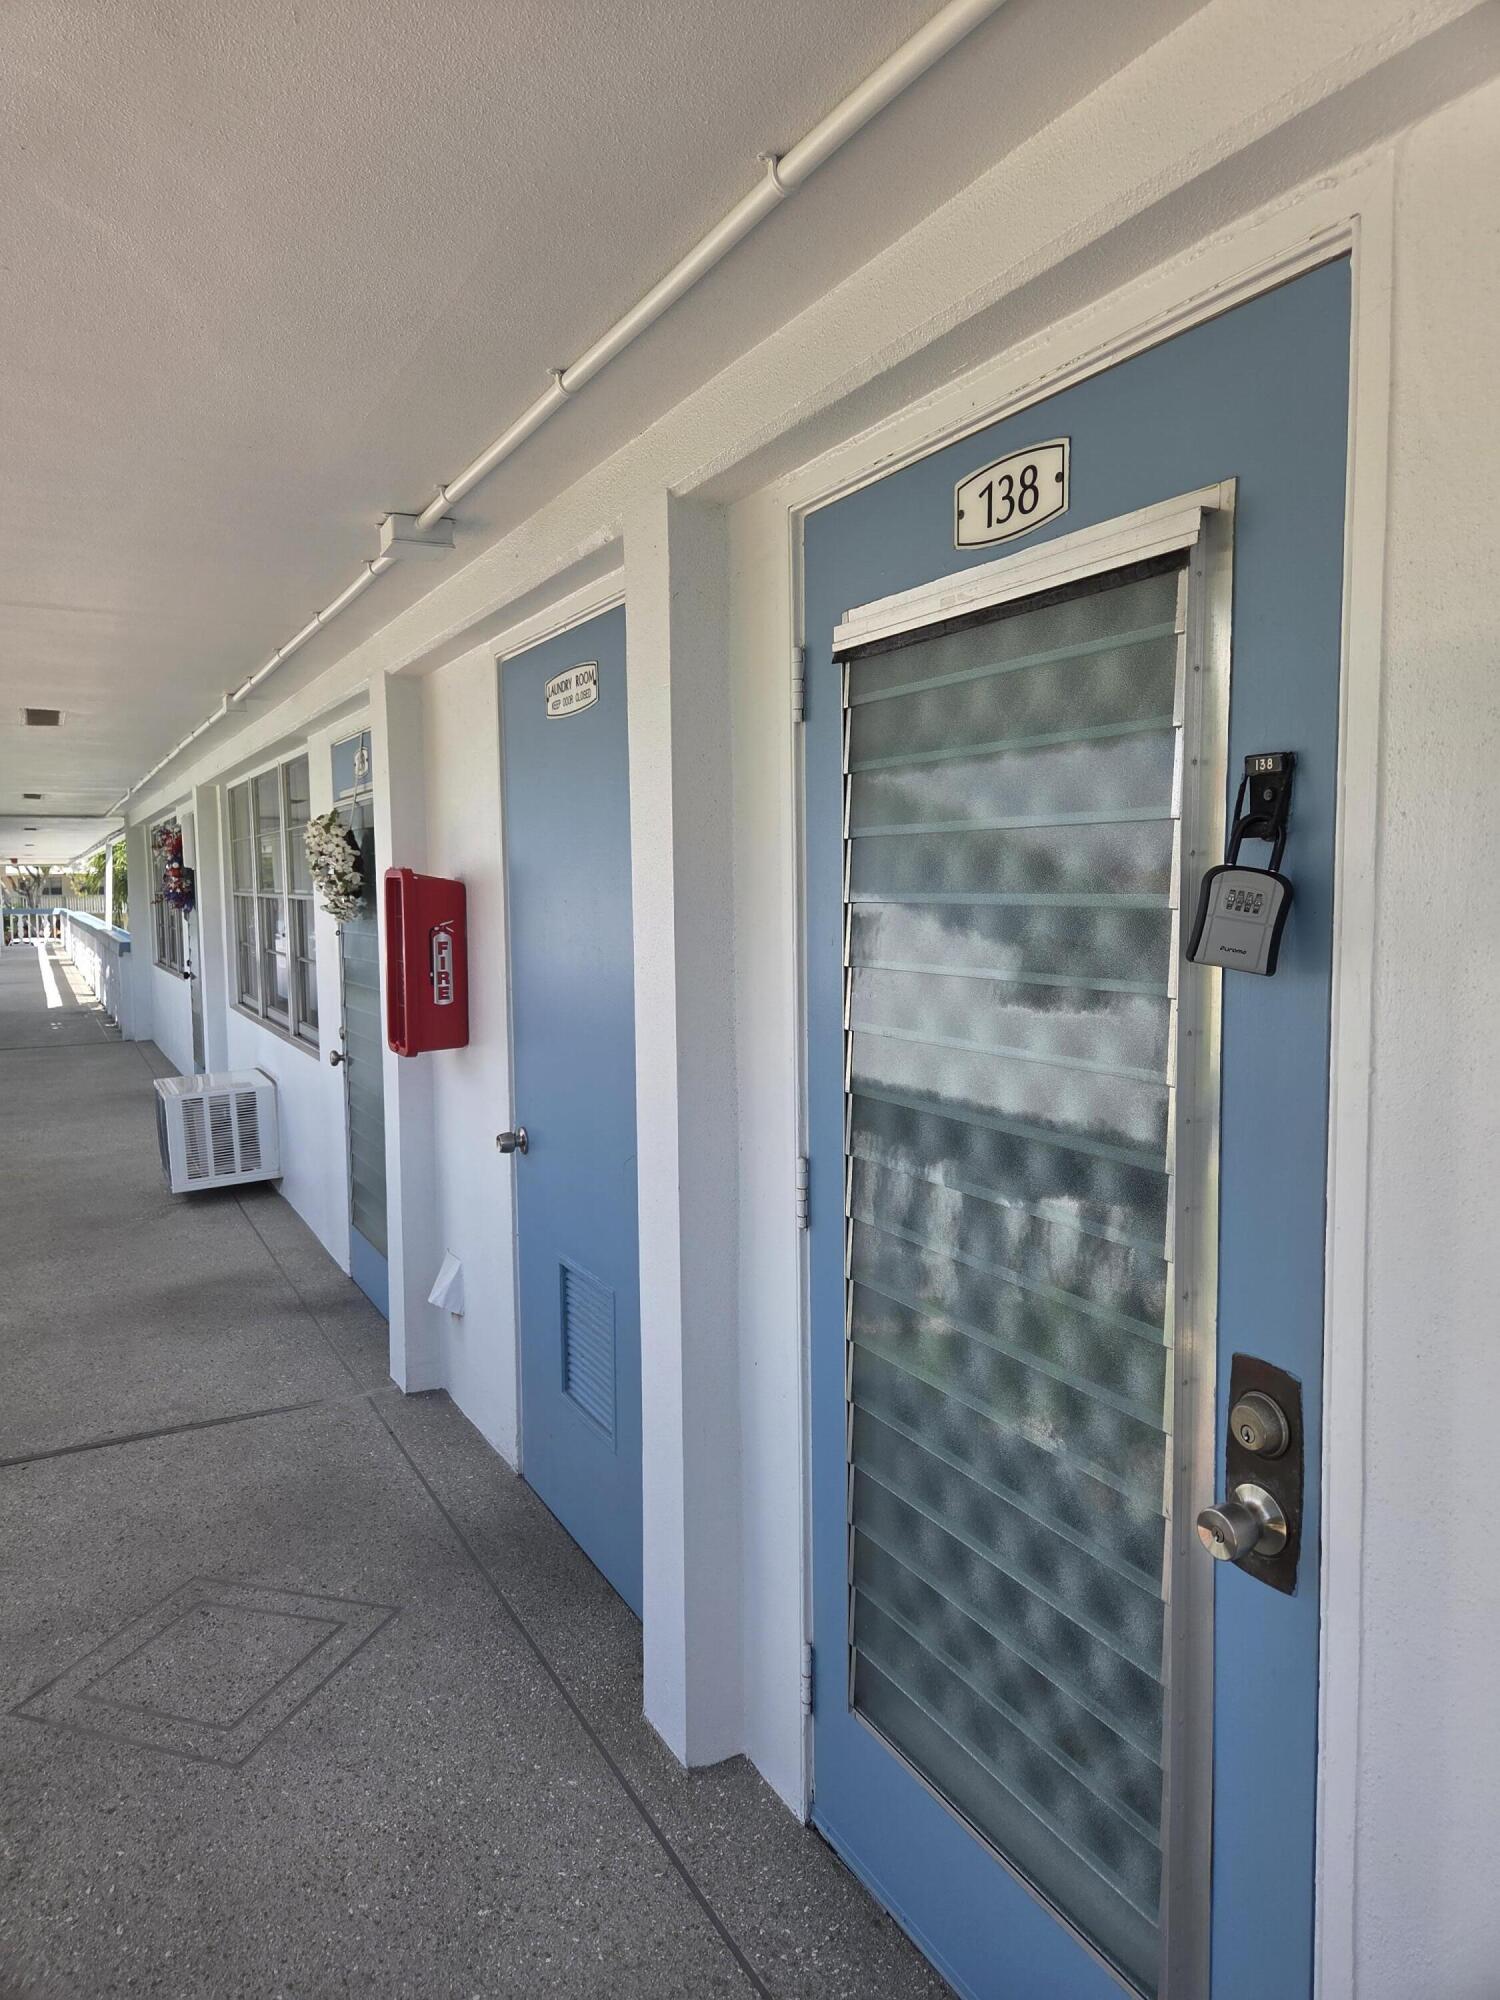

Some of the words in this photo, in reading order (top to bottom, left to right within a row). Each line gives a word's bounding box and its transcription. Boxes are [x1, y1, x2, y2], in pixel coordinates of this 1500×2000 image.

[978, 464, 1039, 528] 138
[548, 676, 573, 698] LAUNDRY
[575, 668, 595, 687] ROOM
[562, 694, 574, 707] DOOR
[575, 687, 592, 702] CLOSED
[1255, 757, 1273, 771] 138
[436, 940, 451, 1001] FIRE
